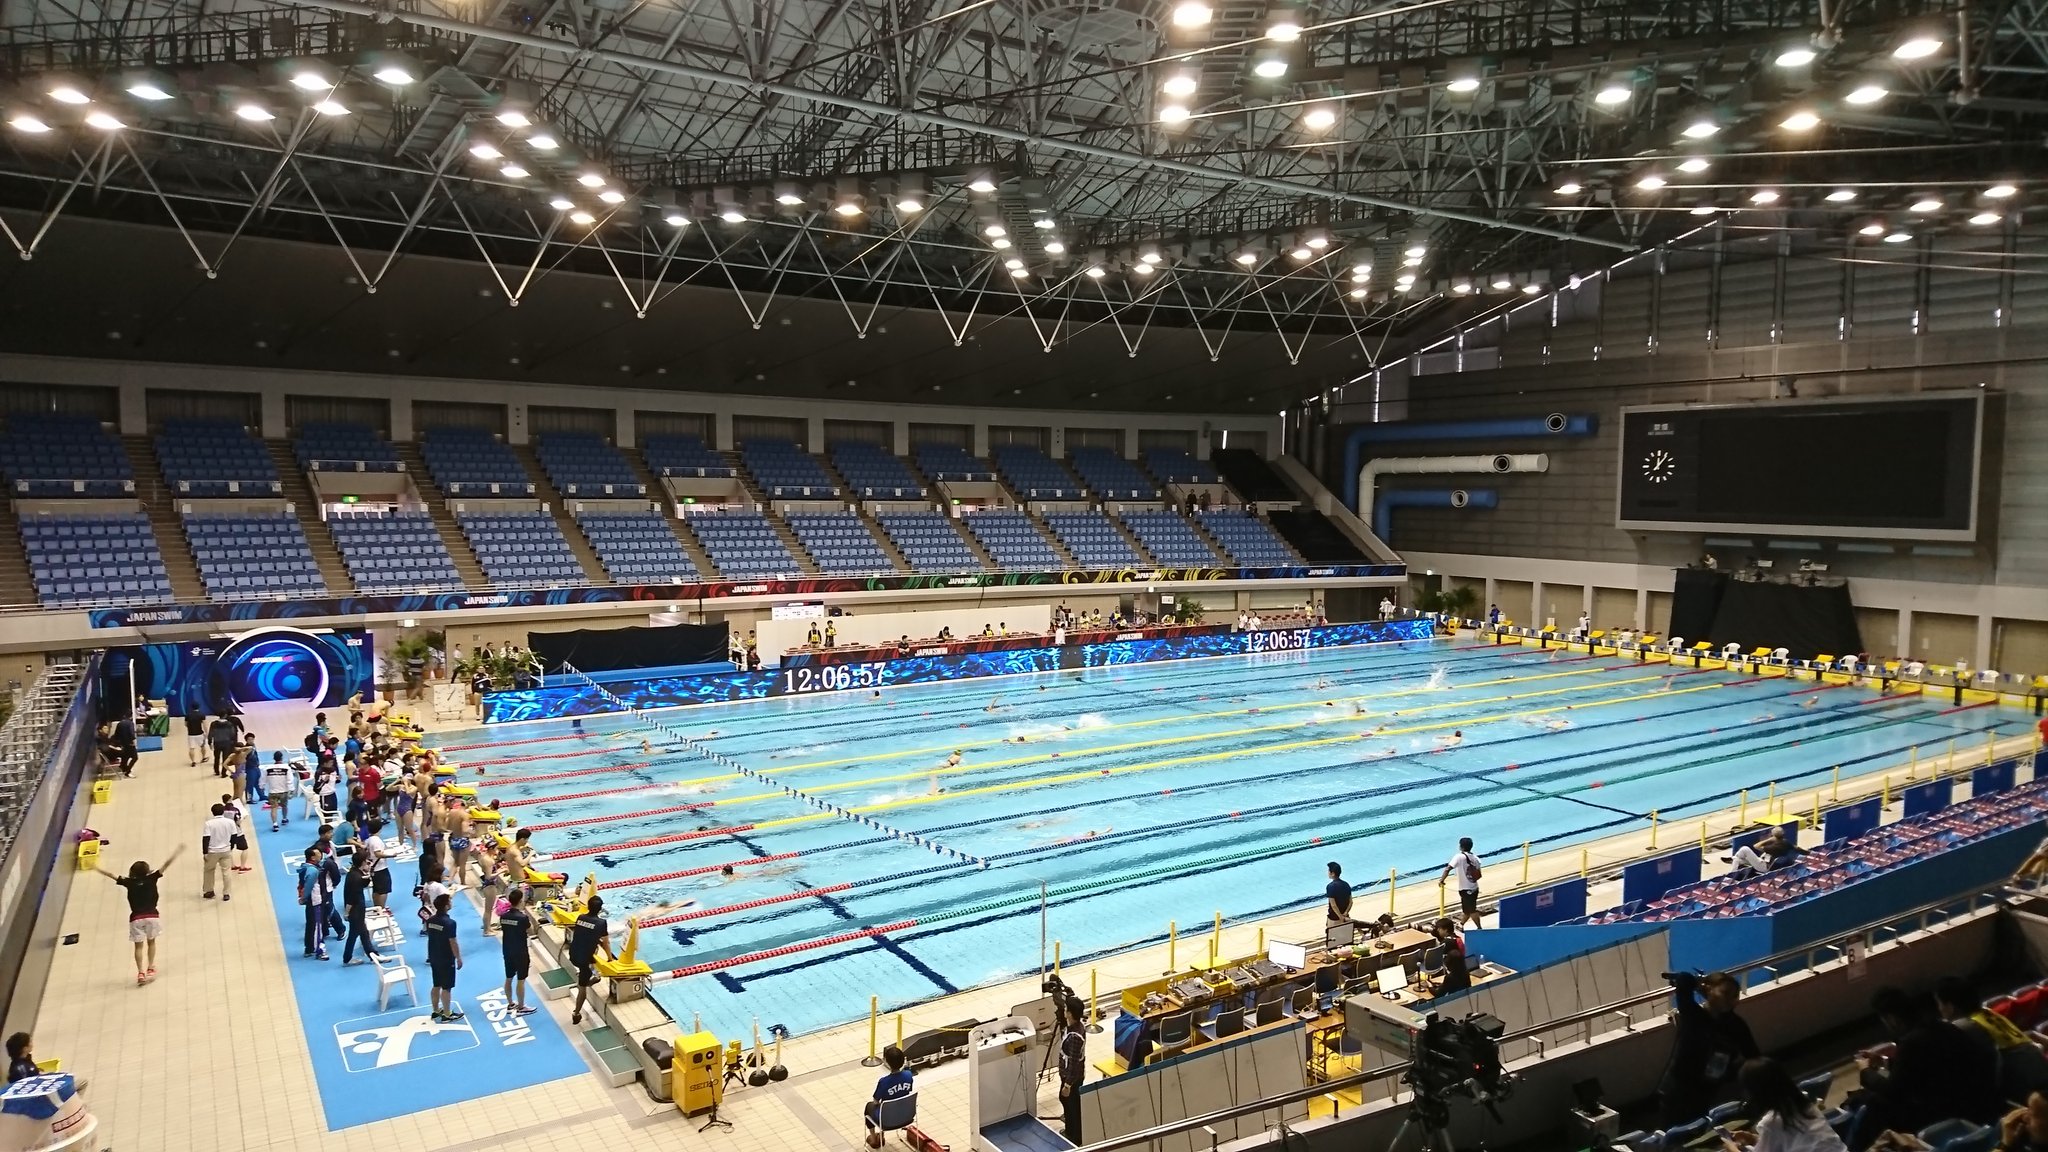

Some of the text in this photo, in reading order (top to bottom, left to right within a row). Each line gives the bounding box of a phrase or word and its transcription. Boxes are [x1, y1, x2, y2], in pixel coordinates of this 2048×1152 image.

[1245, 629, 1311, 652] 12:06:57
[784, 662, 887, 693] 12:06:57
[887, 1082, 912, 1096] STAFF
